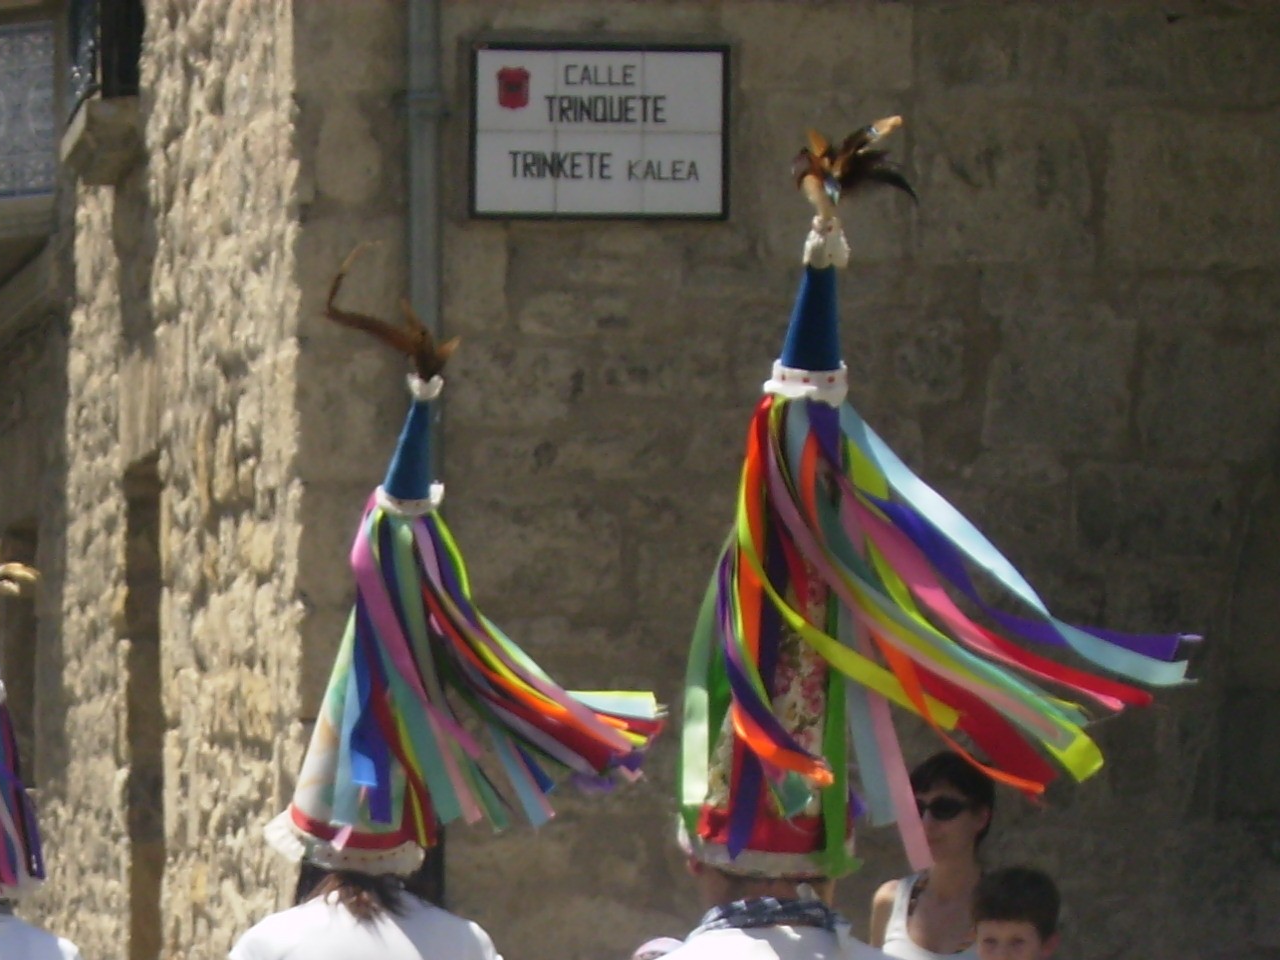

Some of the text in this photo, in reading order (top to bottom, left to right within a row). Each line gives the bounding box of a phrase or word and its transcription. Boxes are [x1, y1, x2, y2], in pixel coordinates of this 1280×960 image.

[564, 64, 636, 87] CALLE
[543, 94, 667, 123] TRINQUETE
[509, 151, 700, 181] TRINKETE KALEA
